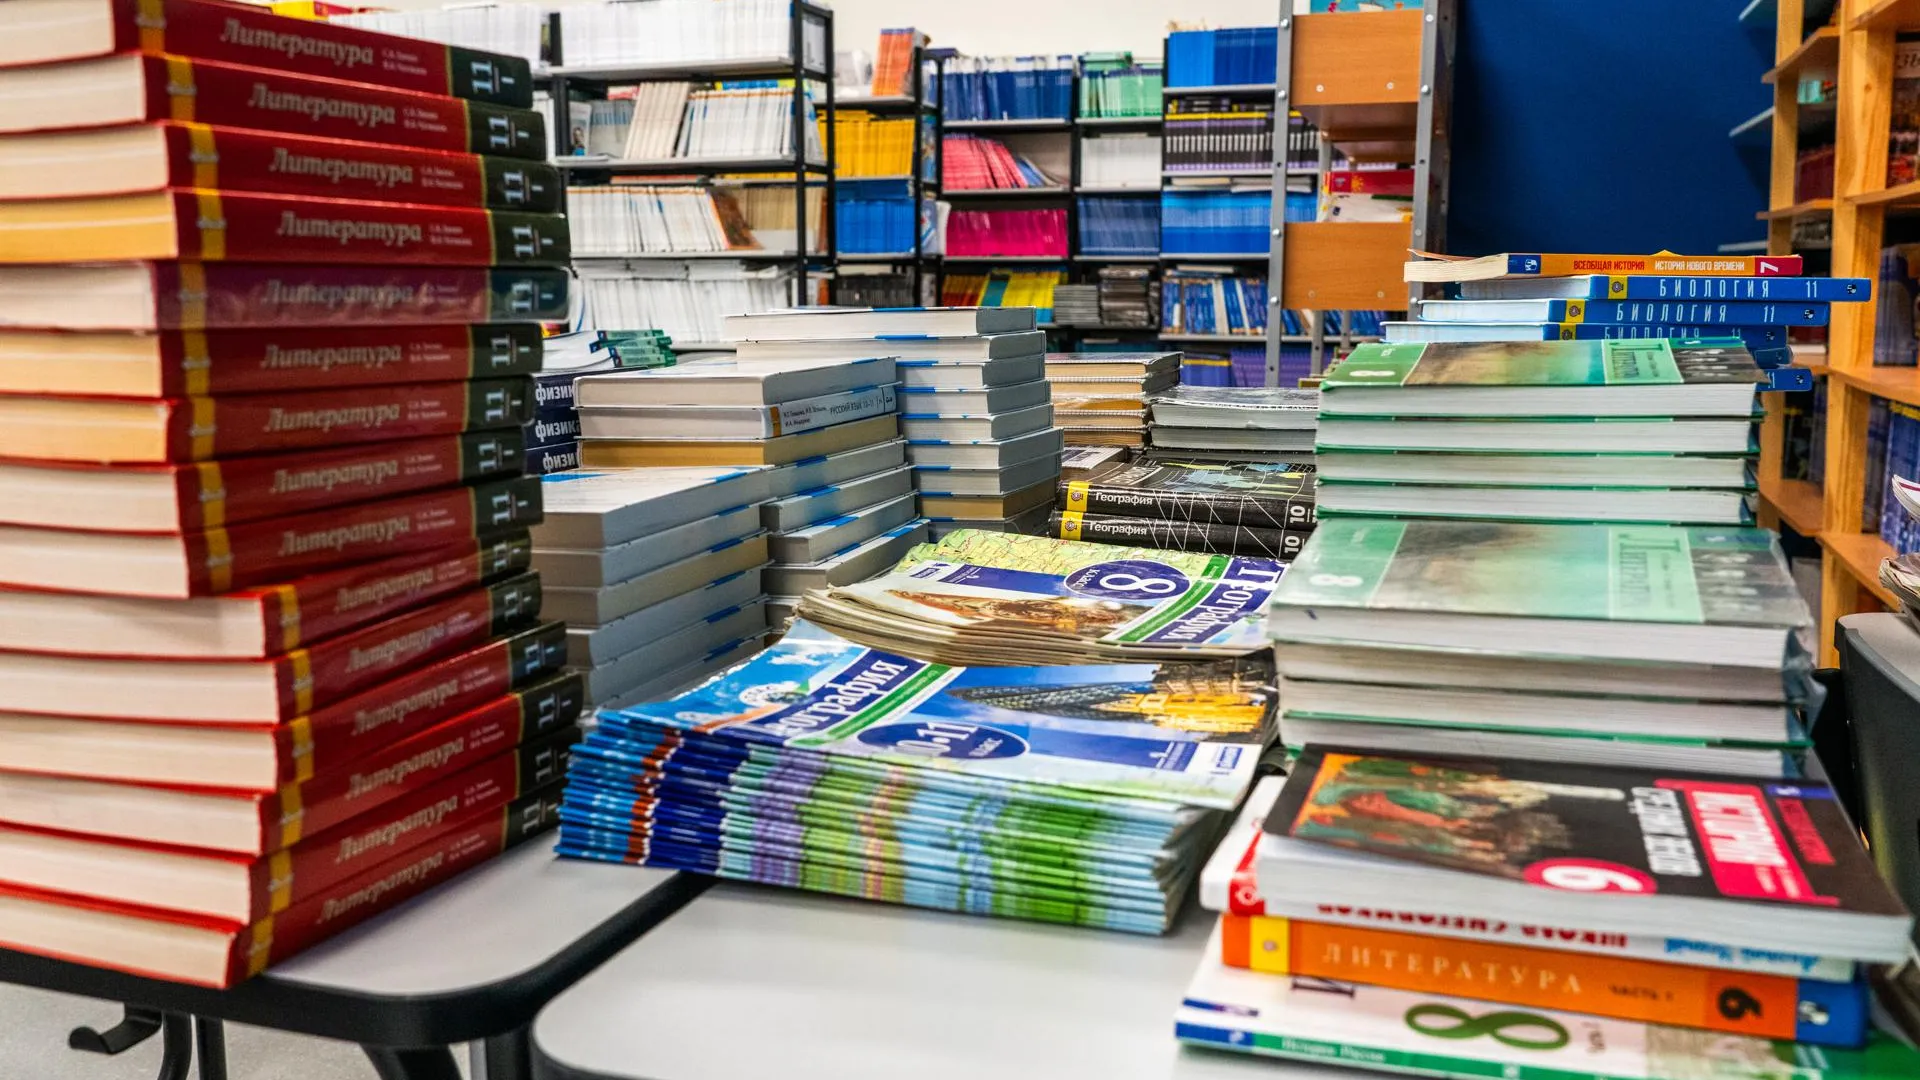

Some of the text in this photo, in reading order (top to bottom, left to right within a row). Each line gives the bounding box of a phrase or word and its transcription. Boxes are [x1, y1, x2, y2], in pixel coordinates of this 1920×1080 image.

[220, 18, 374, 65] Литература
[471, 61, 493, 94] 11
[248, 84, 395, 126] Литература
[488, 116, 509, 149] 11
[269, 147, 413, 186] Литература
[504, 171, 525, 203] 11
[277, 211, 421, 245] Литература
[512, 225, 534, 258] 11
[1573, 260, 1645, 271] ВСЕОБЩАЯ ИСТОРИЯ
[1655, 261, 1745, 271] ИСТОРИЯ НОВОГО ВРЕМЕНИ
[1760, 261, 1779, 274] 7
[511, 280, 533, 312] 11
[1659, 279, 1769, 298] БИОЛОГИЯ
[1806, 281, 1818, 298] 11
[1616, 303, 1727, 323] БИОЛОГИЯ
[1763, 305, 1775, 323] 11
[260, 345, 402, 370] Литература
[490, 337, 511, 367] 11
[264, 404, 400, 433] Литература
[485, 389, 504, 421] 11
[479, 442, 498, 472] 11
[542, 452, 579, 474] физи
[270, 460, 398, 493] Литература
[492, 494, 512, 526] 11
[1095, 492, 1153, 506] География
[1089, 521, 1148, 536] География
[1289, 505, 1306, 524] 10
[278, 514, 410, 556] Литература
[1284, 536, 1300, 554] 10
[1100, 573, 1177, 594] 8
[1309, 573, 1364, 588] 8
[1160, 567, 1282, 640] География
[1541, 865, 1645, 892] 6
[1322, 943, 1582, 995] ЛИТЕРАТУРА
[1403, 1003, 1571, 1051] 8
